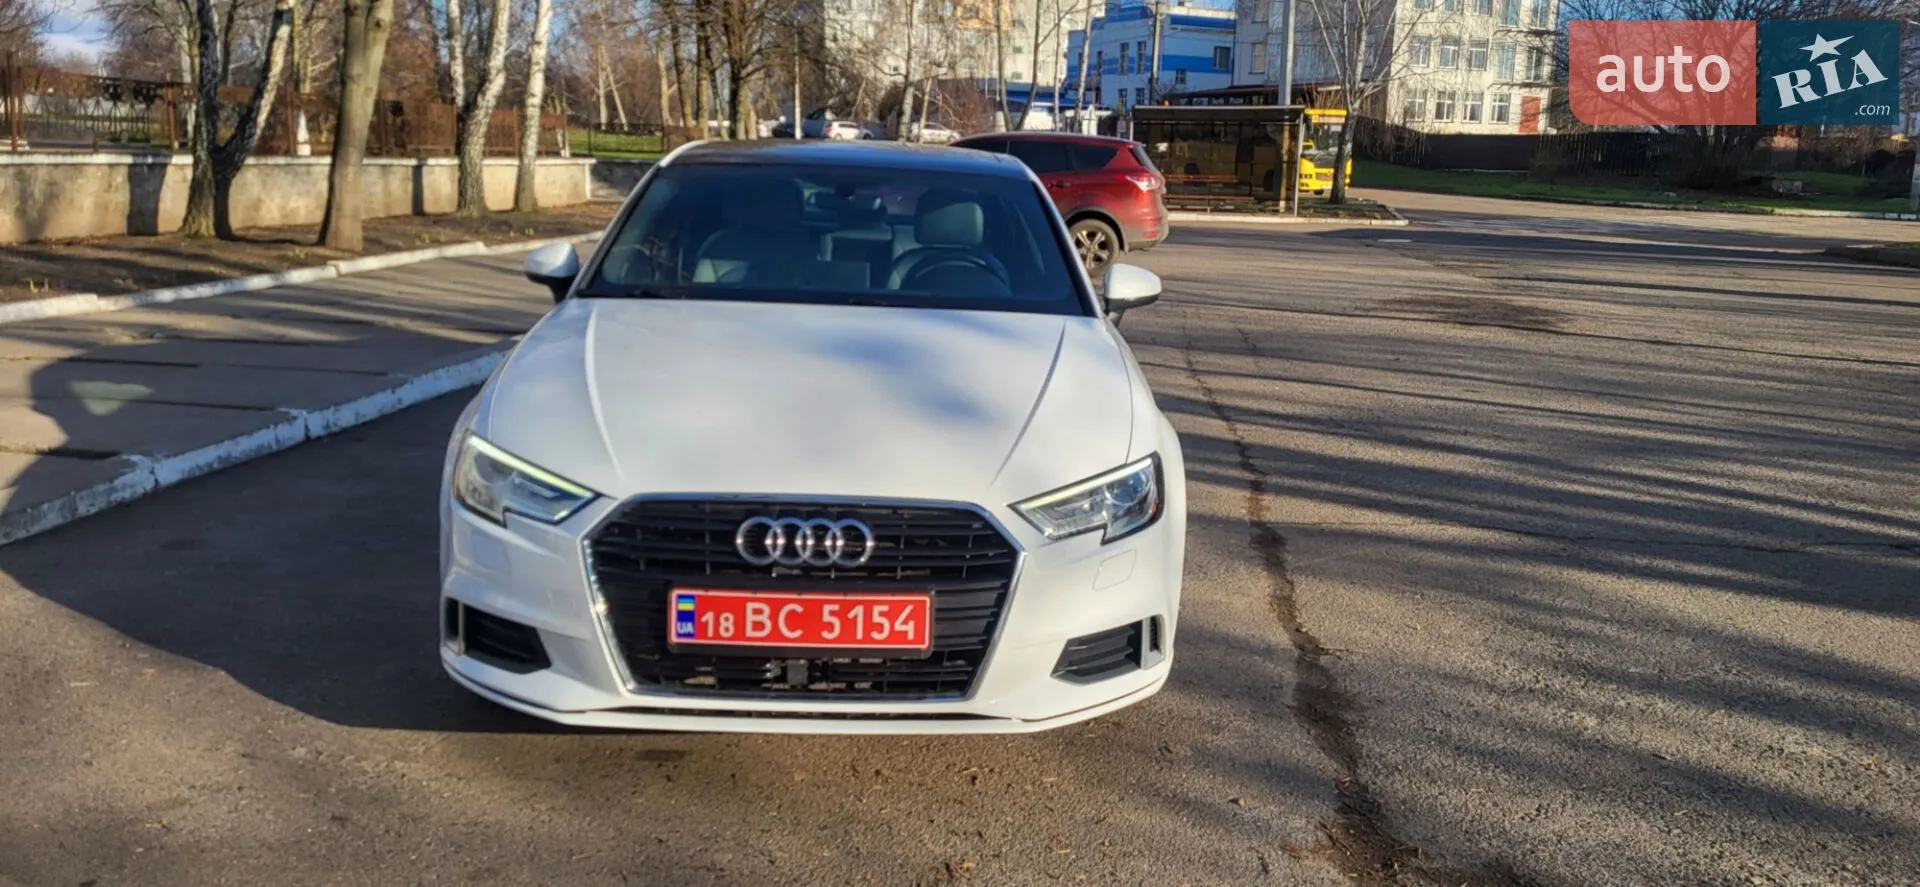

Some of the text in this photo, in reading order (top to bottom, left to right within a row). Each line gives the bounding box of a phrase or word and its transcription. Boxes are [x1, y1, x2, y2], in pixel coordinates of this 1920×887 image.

[677, 622, 694, 634] UA
[700, 601, 915, 640] 18 BC 5154
